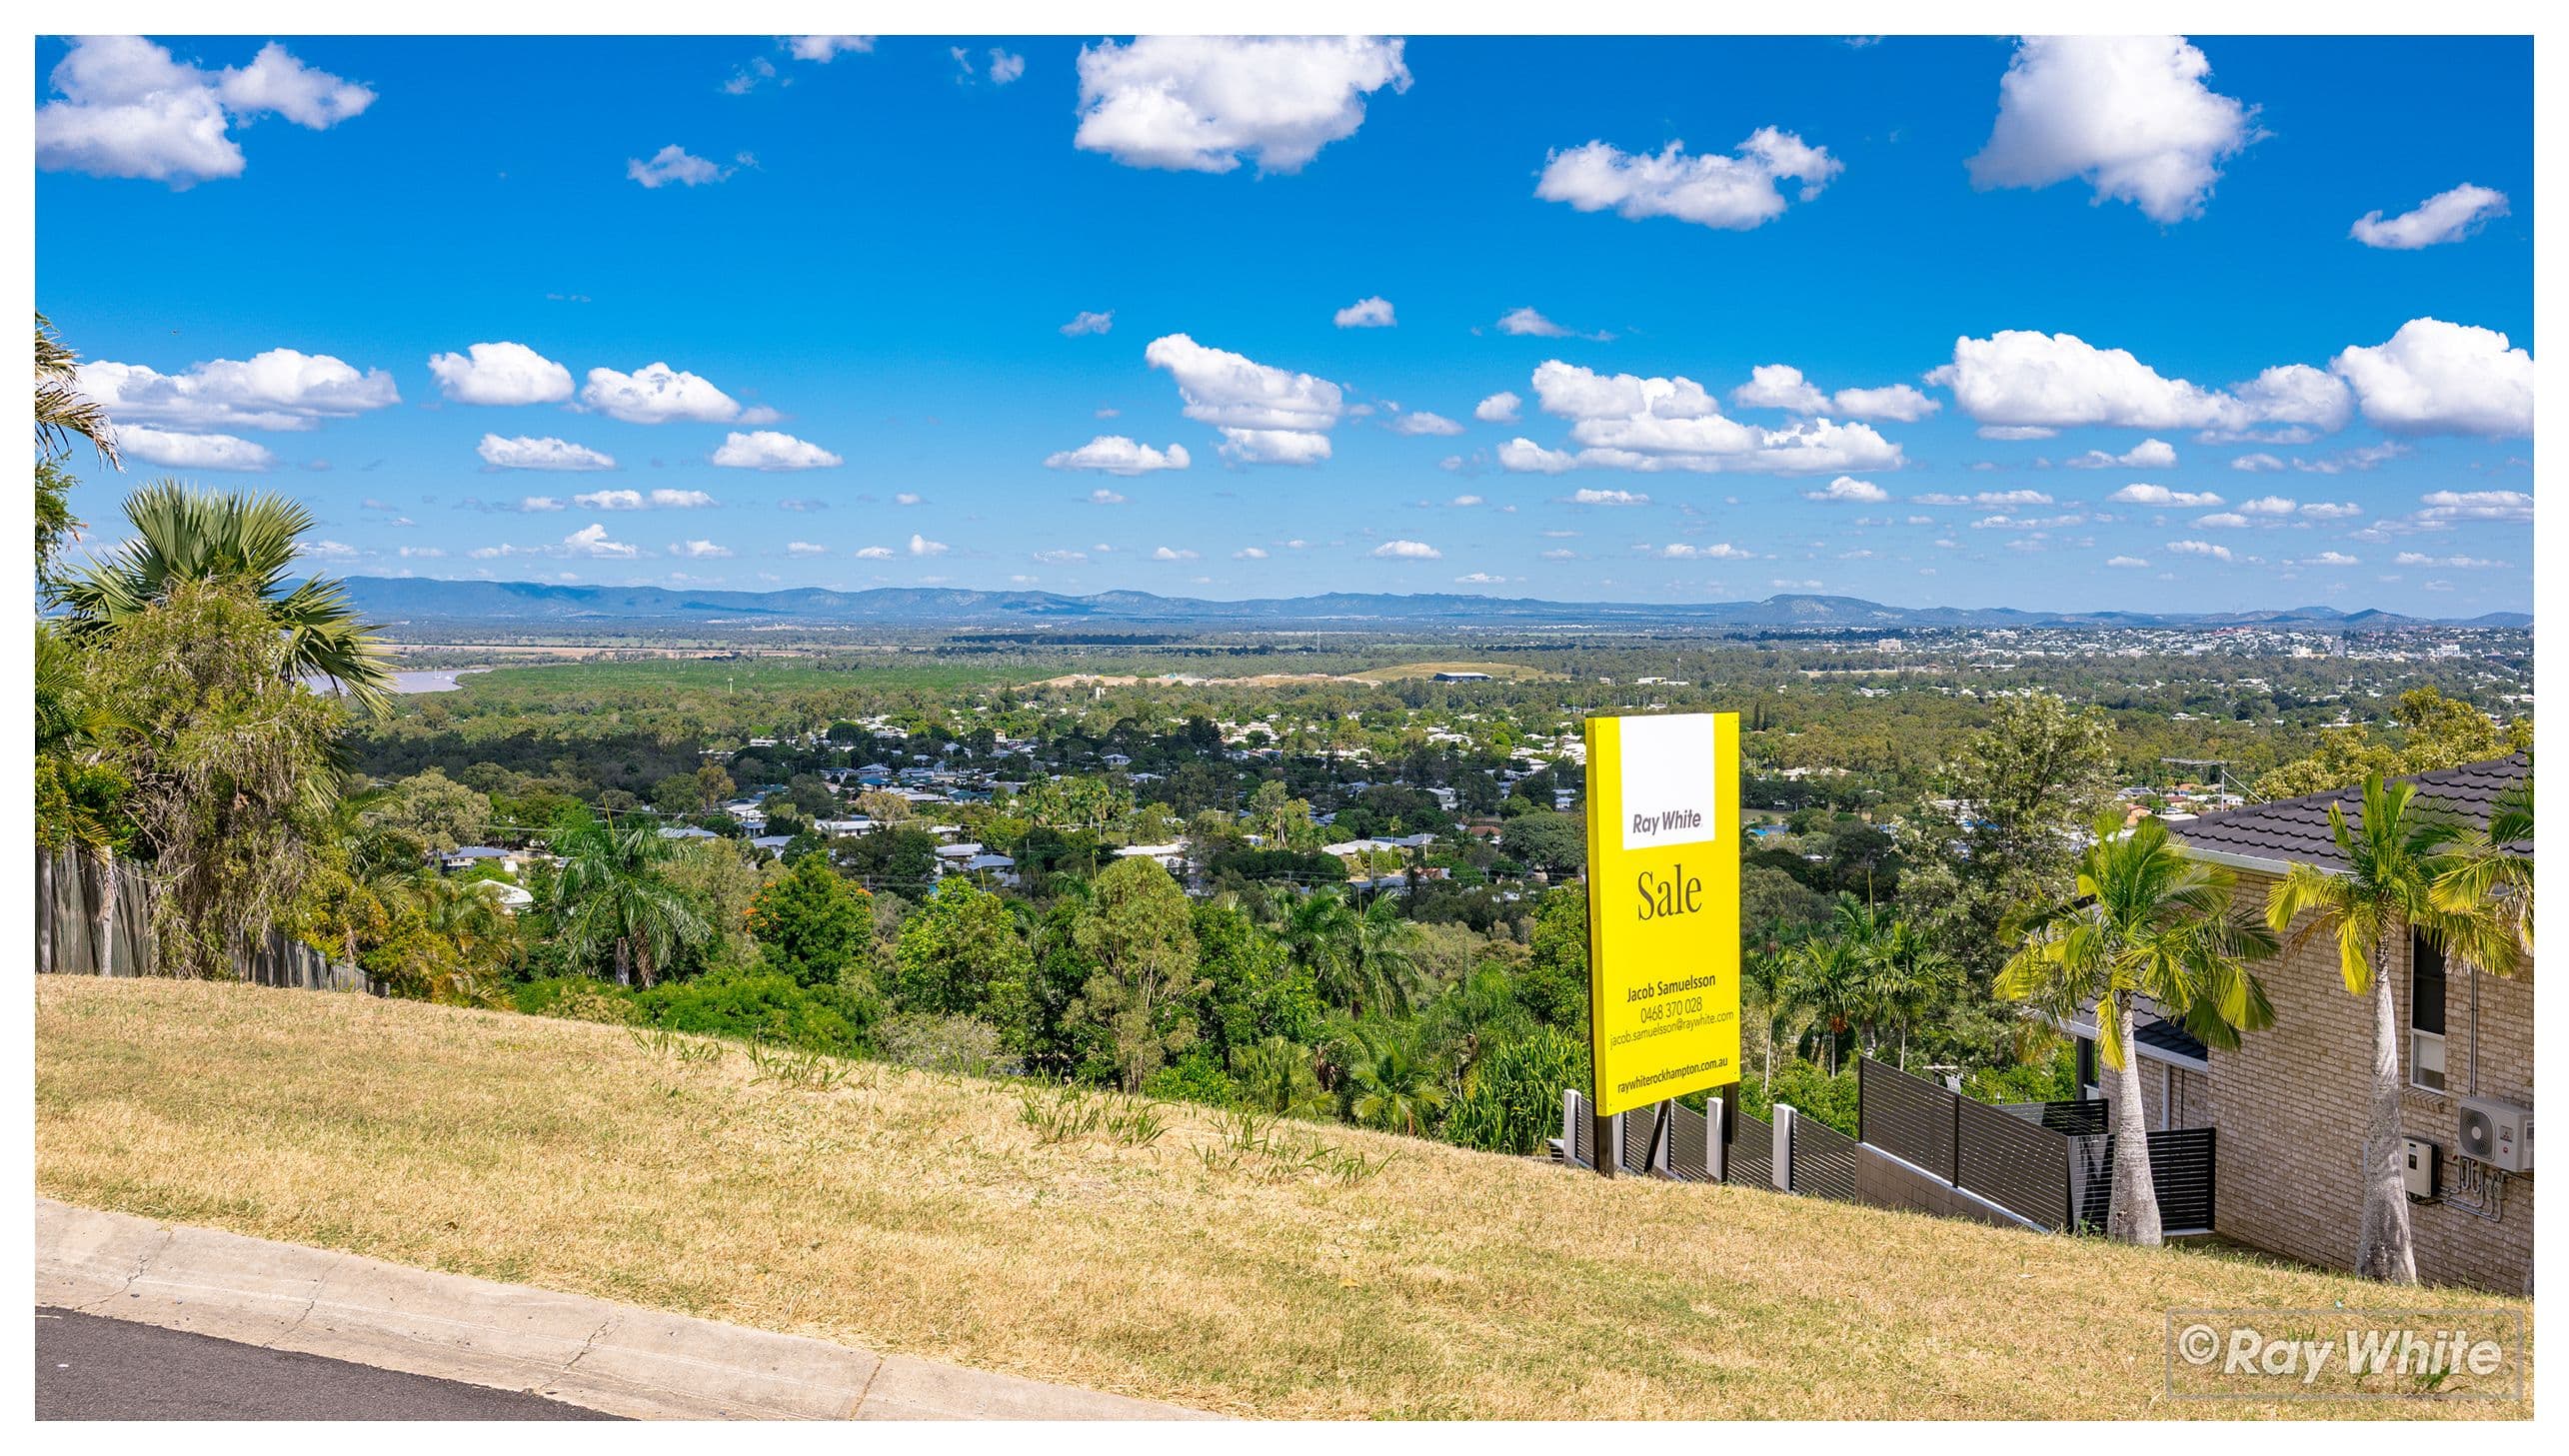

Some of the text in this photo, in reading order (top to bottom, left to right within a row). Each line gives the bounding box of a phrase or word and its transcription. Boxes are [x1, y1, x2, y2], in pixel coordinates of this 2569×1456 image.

[1632, 809, 1702, 835] Ray White
[1637, 863, 1702, 920] Sale
[1627, 974, 1716, 1002] Jacob Samuelsson
[1640, 996, 1703, 1023] 0468 370 028
[1609, 1010, 1734, 1050] jacob.samuelsson@raywhite.com
[1617, 1057, 1728, 1094] raywhiterockhampton.com.au
